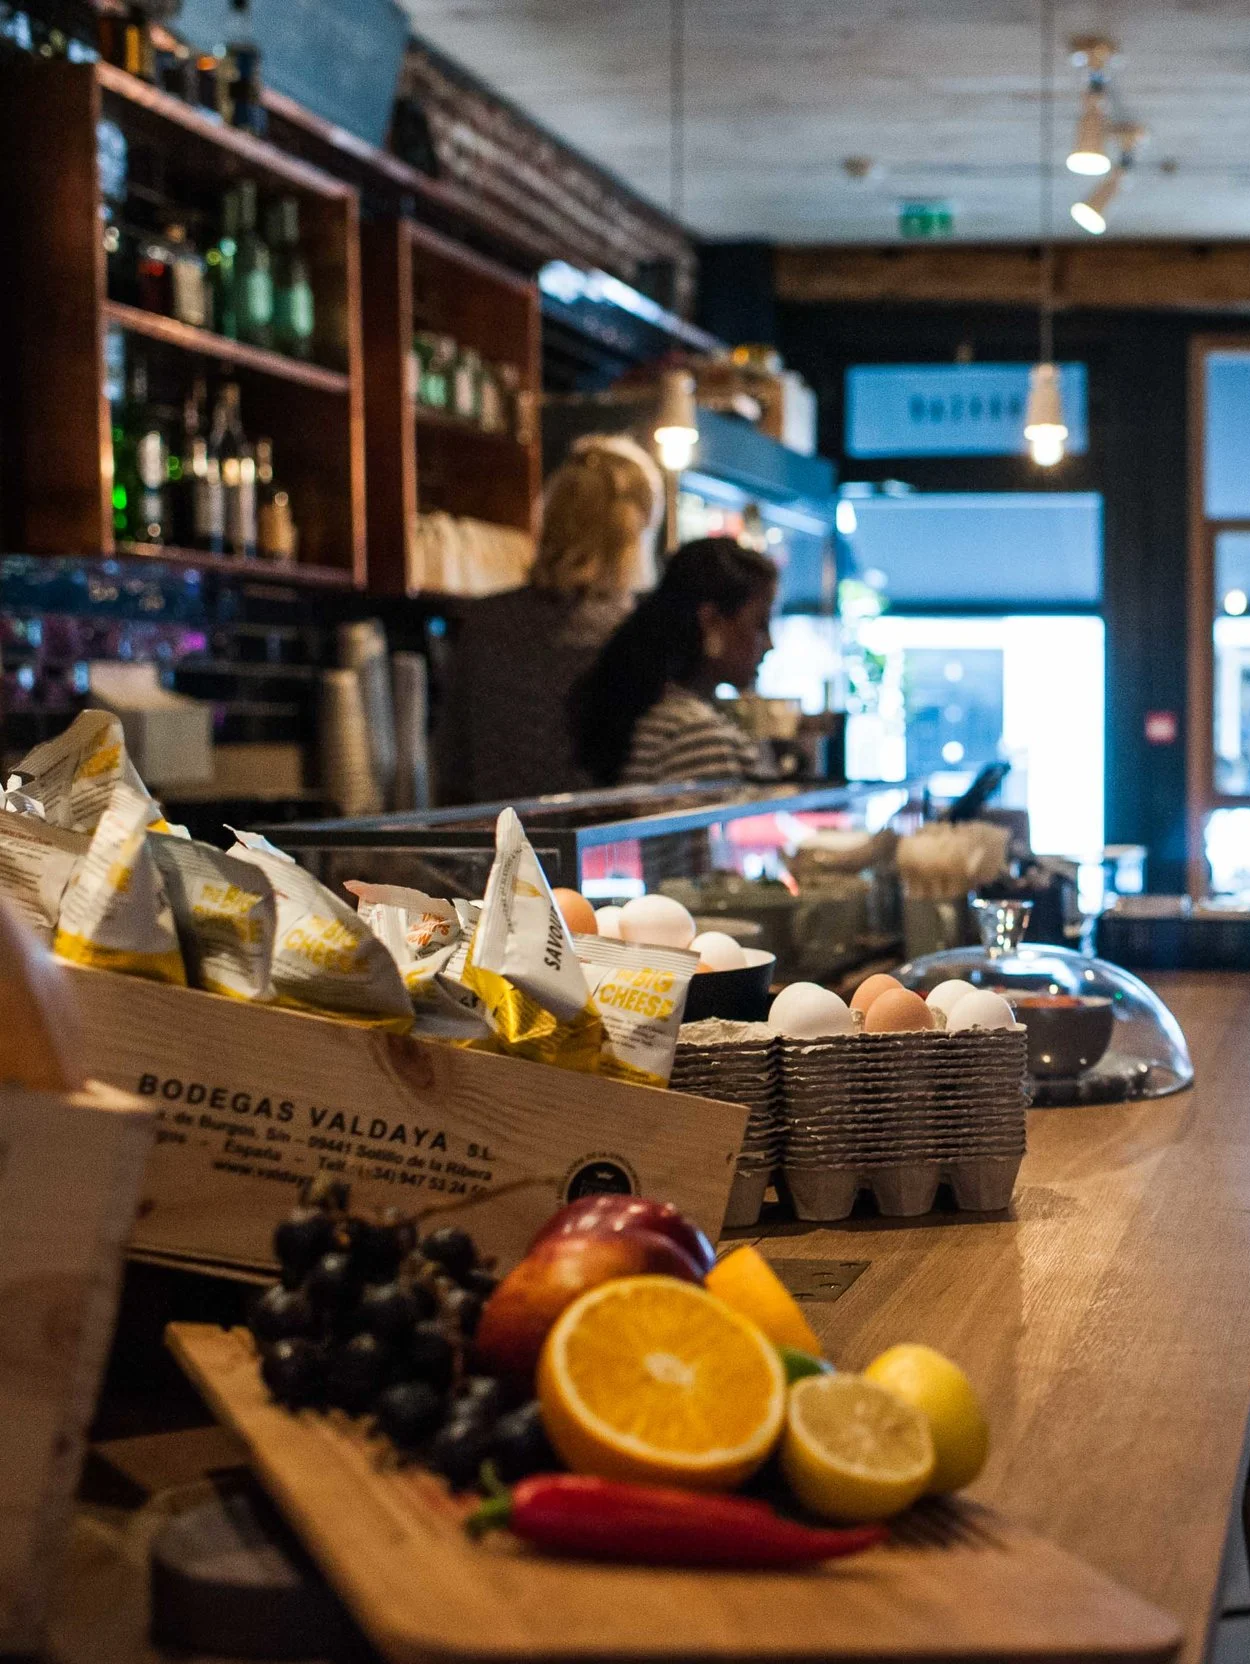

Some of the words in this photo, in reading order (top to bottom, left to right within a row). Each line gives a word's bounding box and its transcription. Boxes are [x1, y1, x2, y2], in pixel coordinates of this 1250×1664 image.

[632, 967, 674, 993] BIG
[599, 983, 675, 1022] CHEESE
[138, 1073, 295, 1122] BODEGAS
[310, 1107, 447, 1151] VALDAYA
